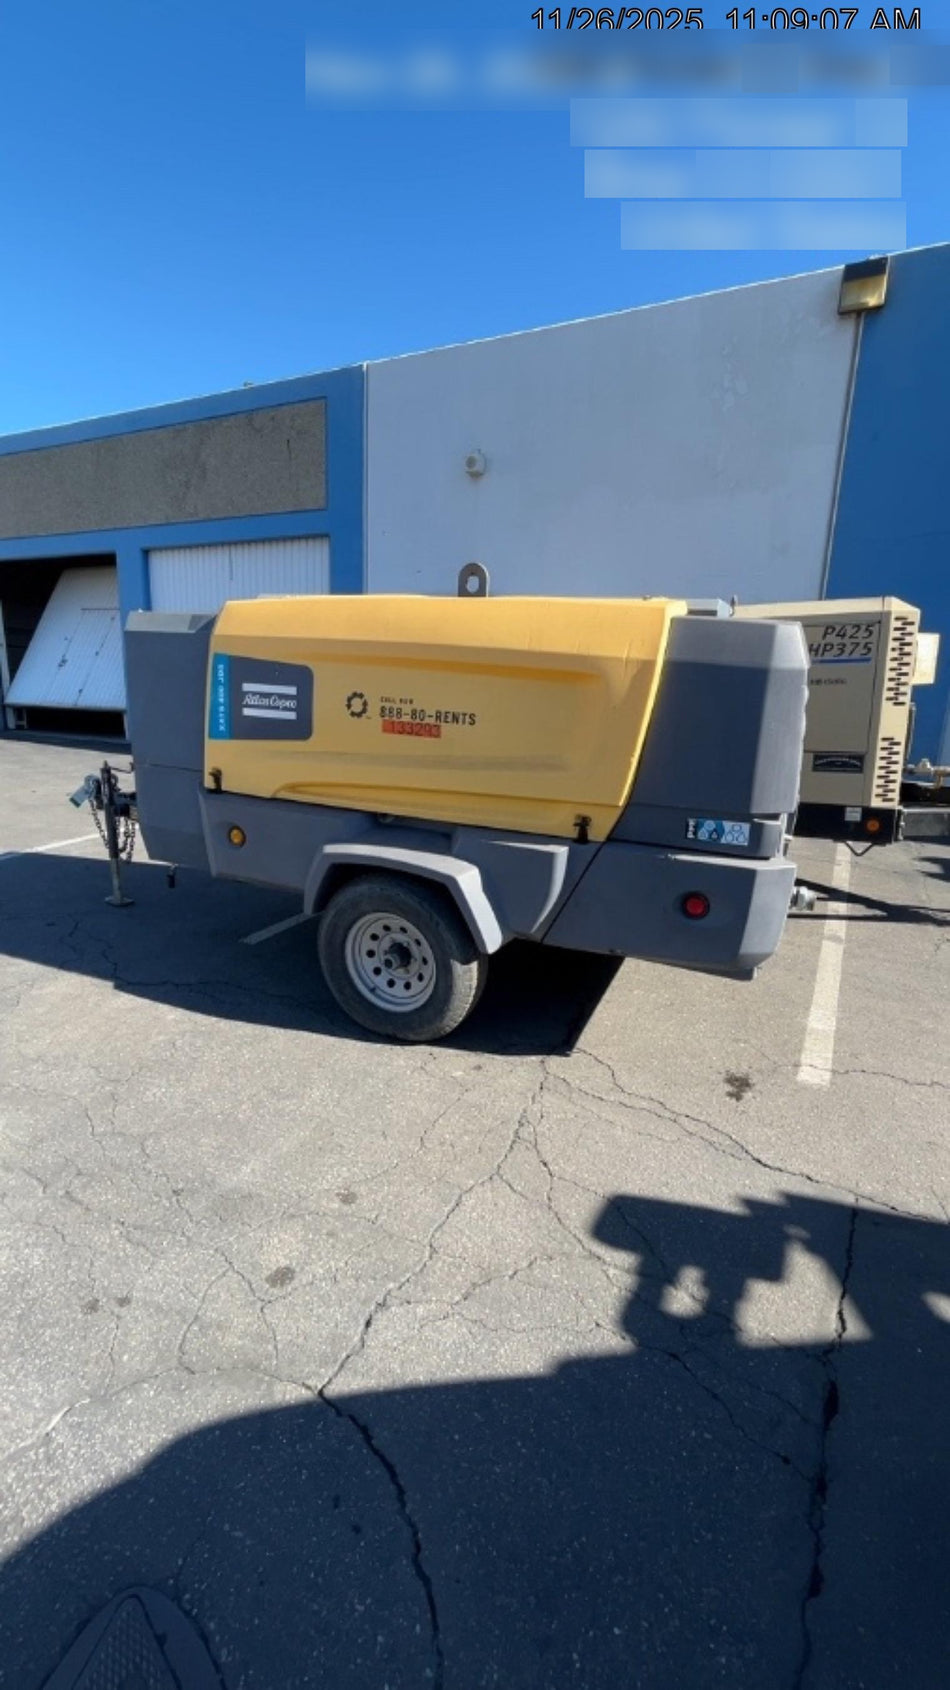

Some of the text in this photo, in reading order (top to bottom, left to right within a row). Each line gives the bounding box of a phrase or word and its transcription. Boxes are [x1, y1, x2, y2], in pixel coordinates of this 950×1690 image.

[822, 624, 874, 640] P425
[242, 693, 297, 709] Atlas Copco
[380, 705, 476, 726] 888-80-RENTS
